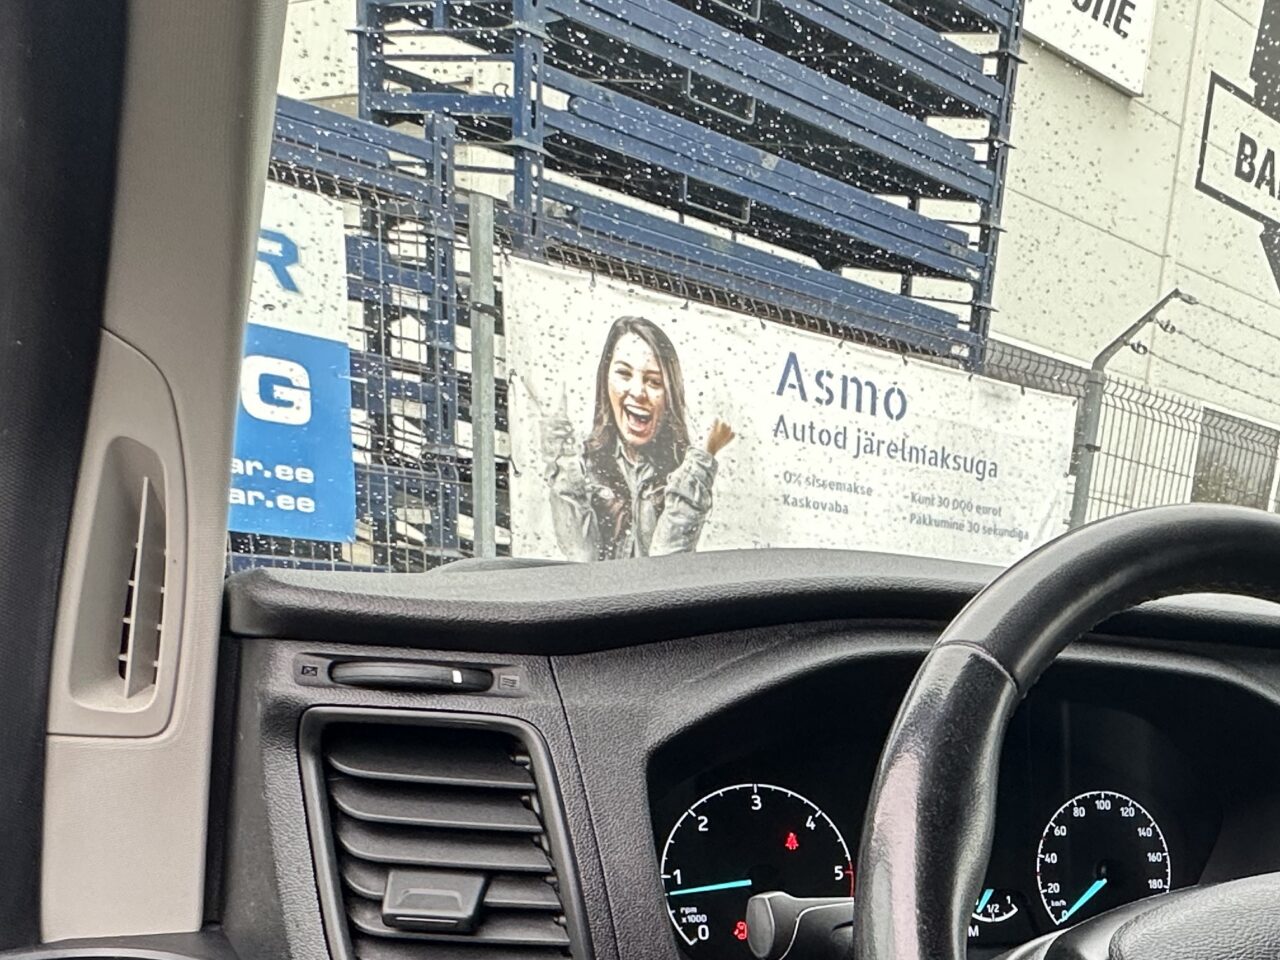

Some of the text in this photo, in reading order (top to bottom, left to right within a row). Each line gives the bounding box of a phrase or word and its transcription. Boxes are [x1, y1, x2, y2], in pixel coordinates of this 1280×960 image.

[776, 351, 908, 421] Asmo
[773, 414, 998, 482] Autod järelmaksuga
[782, 494, 849, 515] Kaskovaba
[751, 795, 762, 810] 3
[1095, 799, 1111, 811] 100
[1072, 806, 1086, 818] 80
[1120, 806, 1135, 818] 120
[697, 816, 709, 832] 2
[805, 816, 816, 830] 4
[1053, 825, 1067, 837] 60
[1137, 827, 1153, 838] 140
[1044, 852, 1058, 865] 40
[1147, 852, 1162, 863] 160
[672, 869, 682, 884] 1
[834, 866, 844, 880] 5
[1046, 882, 1060, 894] 20
[1148, 878, 1163, 890] 180
[1005, 895, 1011, 905] 1
[986, 903, 1000, 913] 1/2
[697, 924, 710, 941] 0
